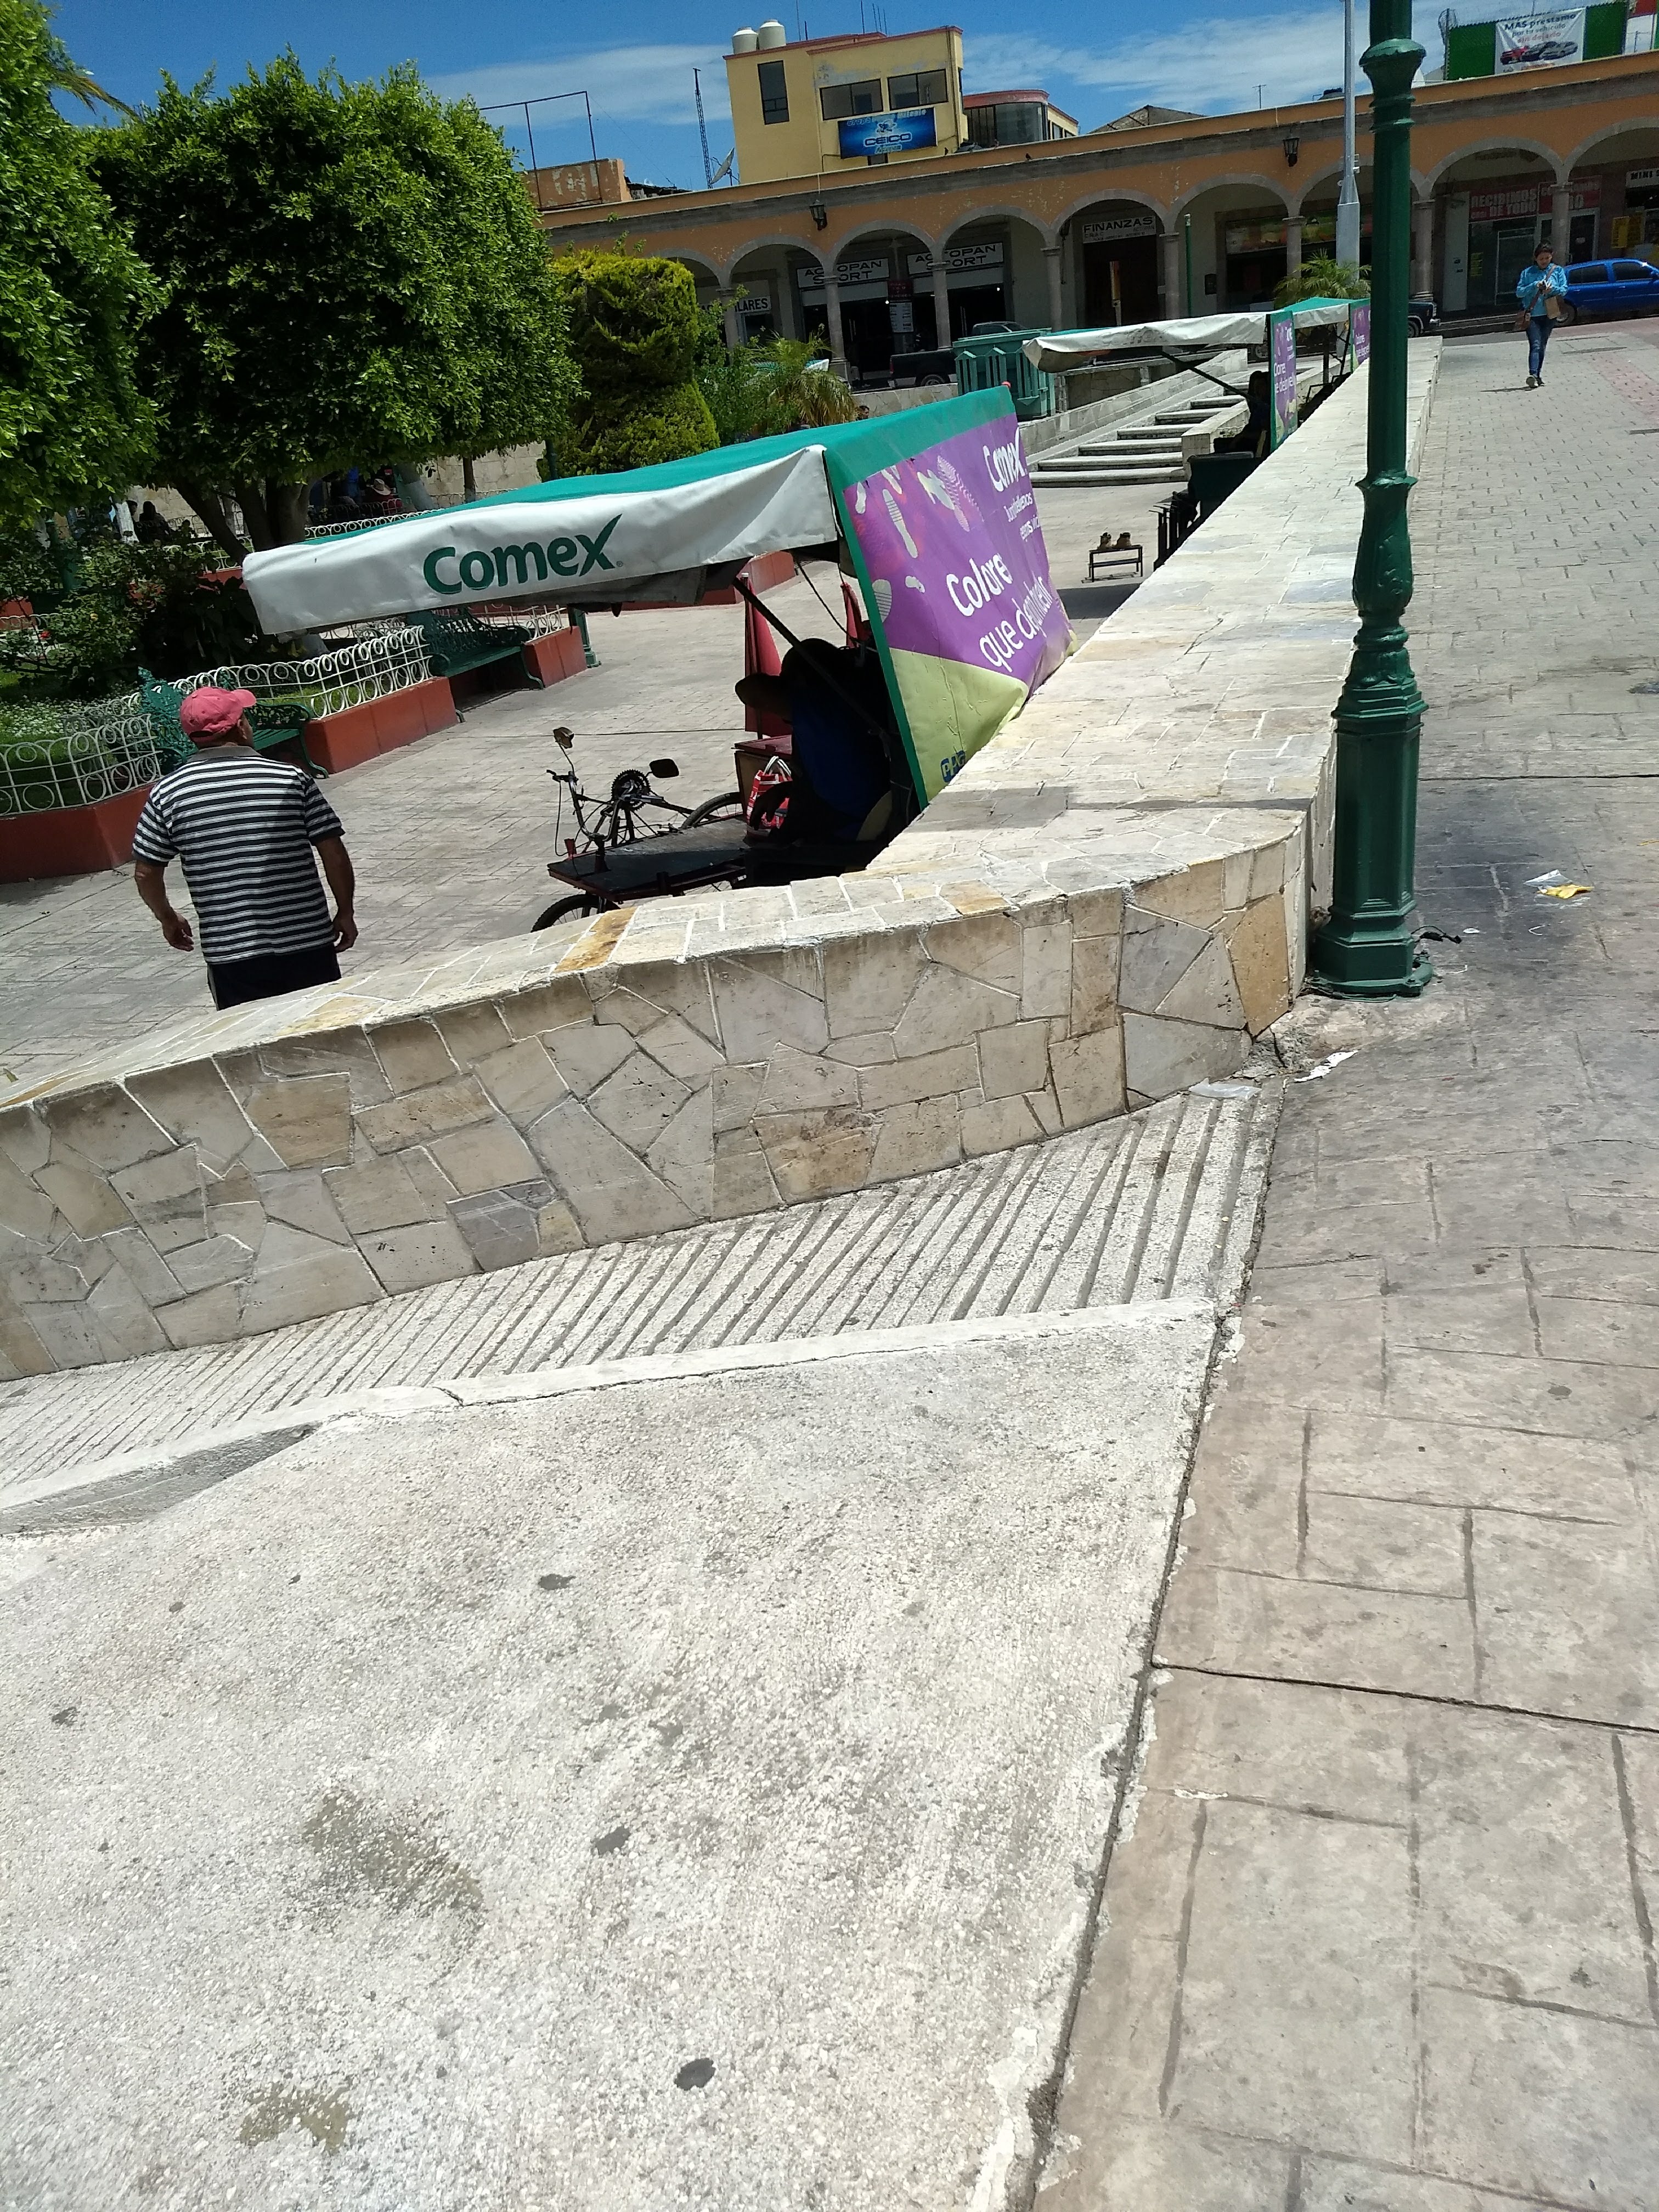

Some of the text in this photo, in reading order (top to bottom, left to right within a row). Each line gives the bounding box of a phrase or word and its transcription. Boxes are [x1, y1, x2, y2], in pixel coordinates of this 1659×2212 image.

[864, 132, 912, 147] CEICO
[1084, 217, 1153, 233] FINANZAS
[916, 245, 996, 262] ACOPAN
[805, 261, 882, 276] ACOPAN
[927, 255, 986, 270] SORT
[812, 271, 872, 284] SORT
[735, 298, 768, 312] LARES
[423, 513, 623, 595] Comex
[946, 553, 1013, 617] Colore
[979, 620, 1024, 673] que
